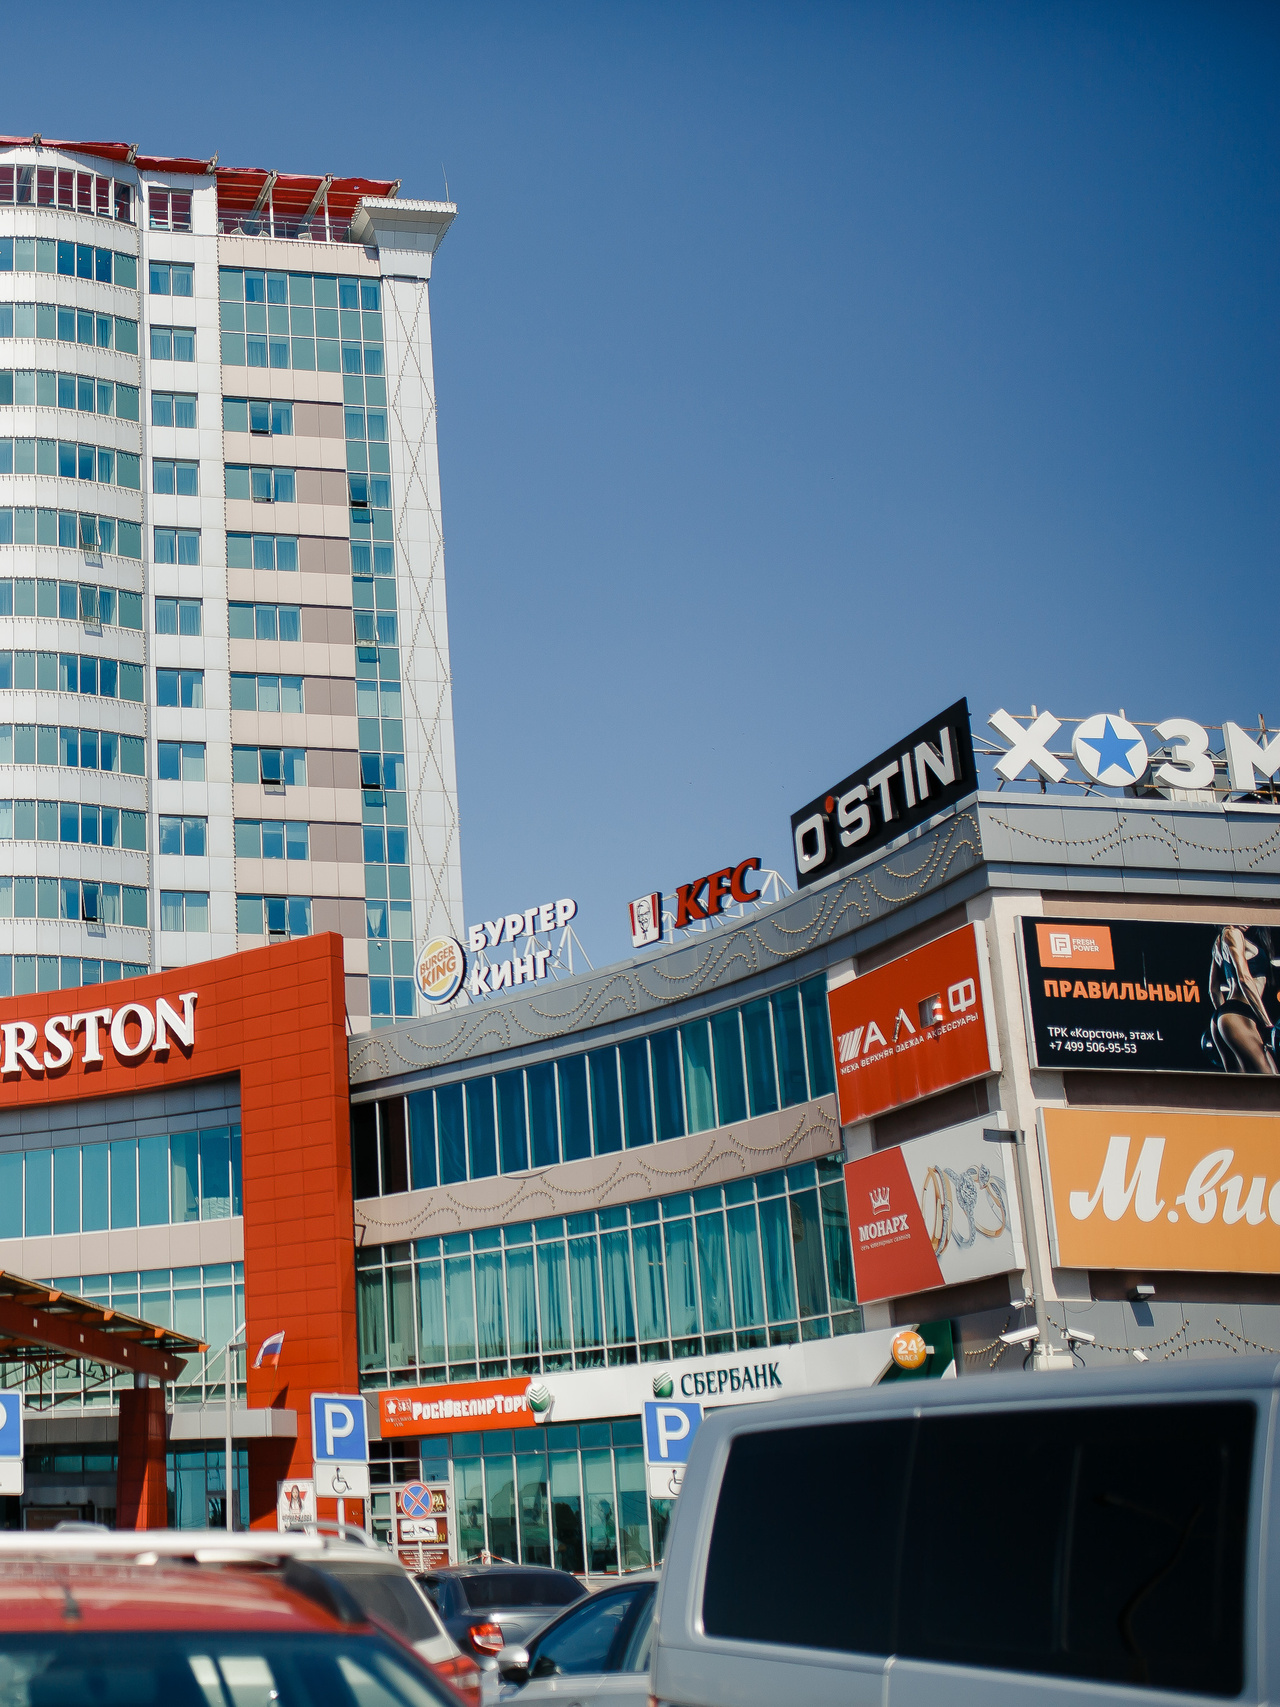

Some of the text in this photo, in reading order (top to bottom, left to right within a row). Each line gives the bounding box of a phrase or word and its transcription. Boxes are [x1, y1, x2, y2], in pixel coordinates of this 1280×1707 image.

[795, 726, 962, 875] O'STIN
[675, 857, 762, 929] KFC
[468, 898, 577, 952] БУРГЕР
[1072, 938, 1096, 946] FRESH
[420, 945, 454, 975] BURGER
[422, 955, 456, 992] KING
[470, 949, 552, 996] КИНГ
[1043, 979, 1201, 1003] ПРАВИЛЬНЫЙ
[840, 1012, 979, 1075] МЕХА ВЕРХНЯЯ ОДЕЖДА АКСЕССУАРЫ
[1047, 1026, 1164, 1042] ТРК «Корстон», этаж L
[1049, 1041, 1138, 1054] +7 499 506-95-53
[1069, 1135, 1280, 1226] М.ви
[858, 1214, 910, 1242] МОНАРХ
[896, 1339, 918, 1354] 24
[681, 1362, 783, 1397] СБЕРБАНК
[325, 1403, 355, 1456] P
[656, 1407, 691, 1458] P
